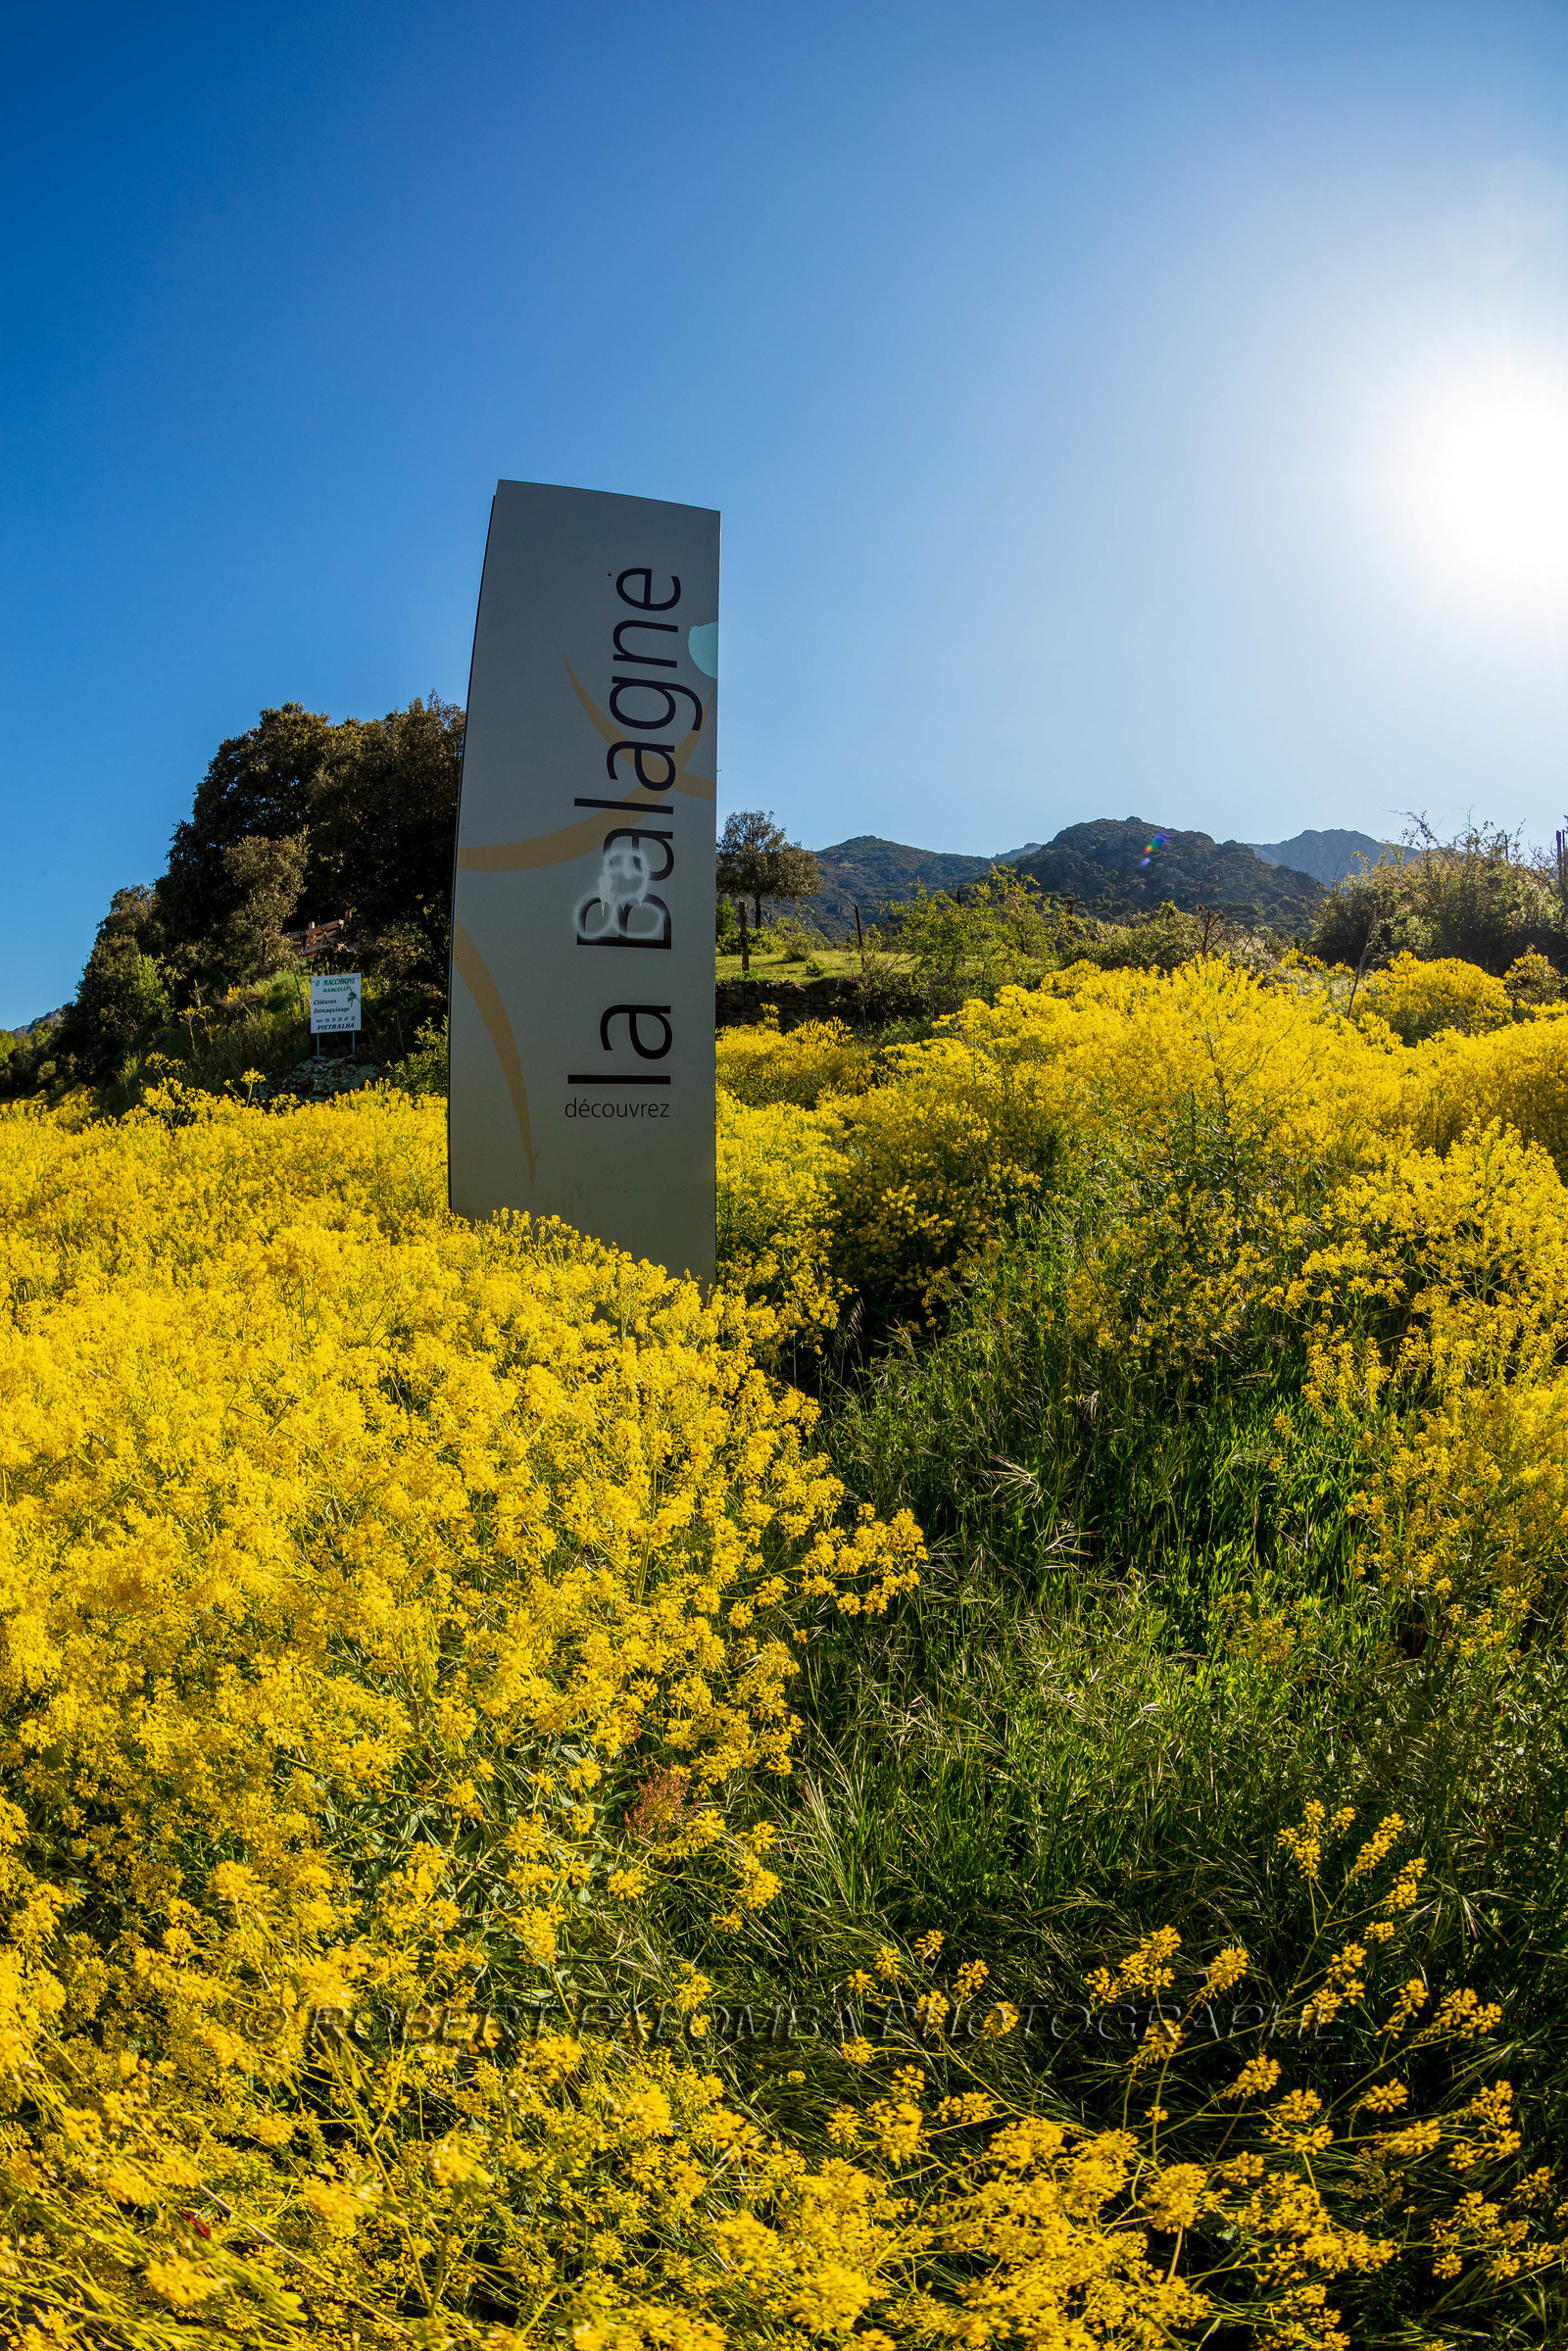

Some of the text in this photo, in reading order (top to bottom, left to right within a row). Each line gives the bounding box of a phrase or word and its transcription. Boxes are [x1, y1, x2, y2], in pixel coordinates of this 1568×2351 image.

[567, 567, 703, 1085] la Balagne
[317, 1022, 355, 1031] PIETRALBA
[564, 1098, 670, 1118] découvrez
